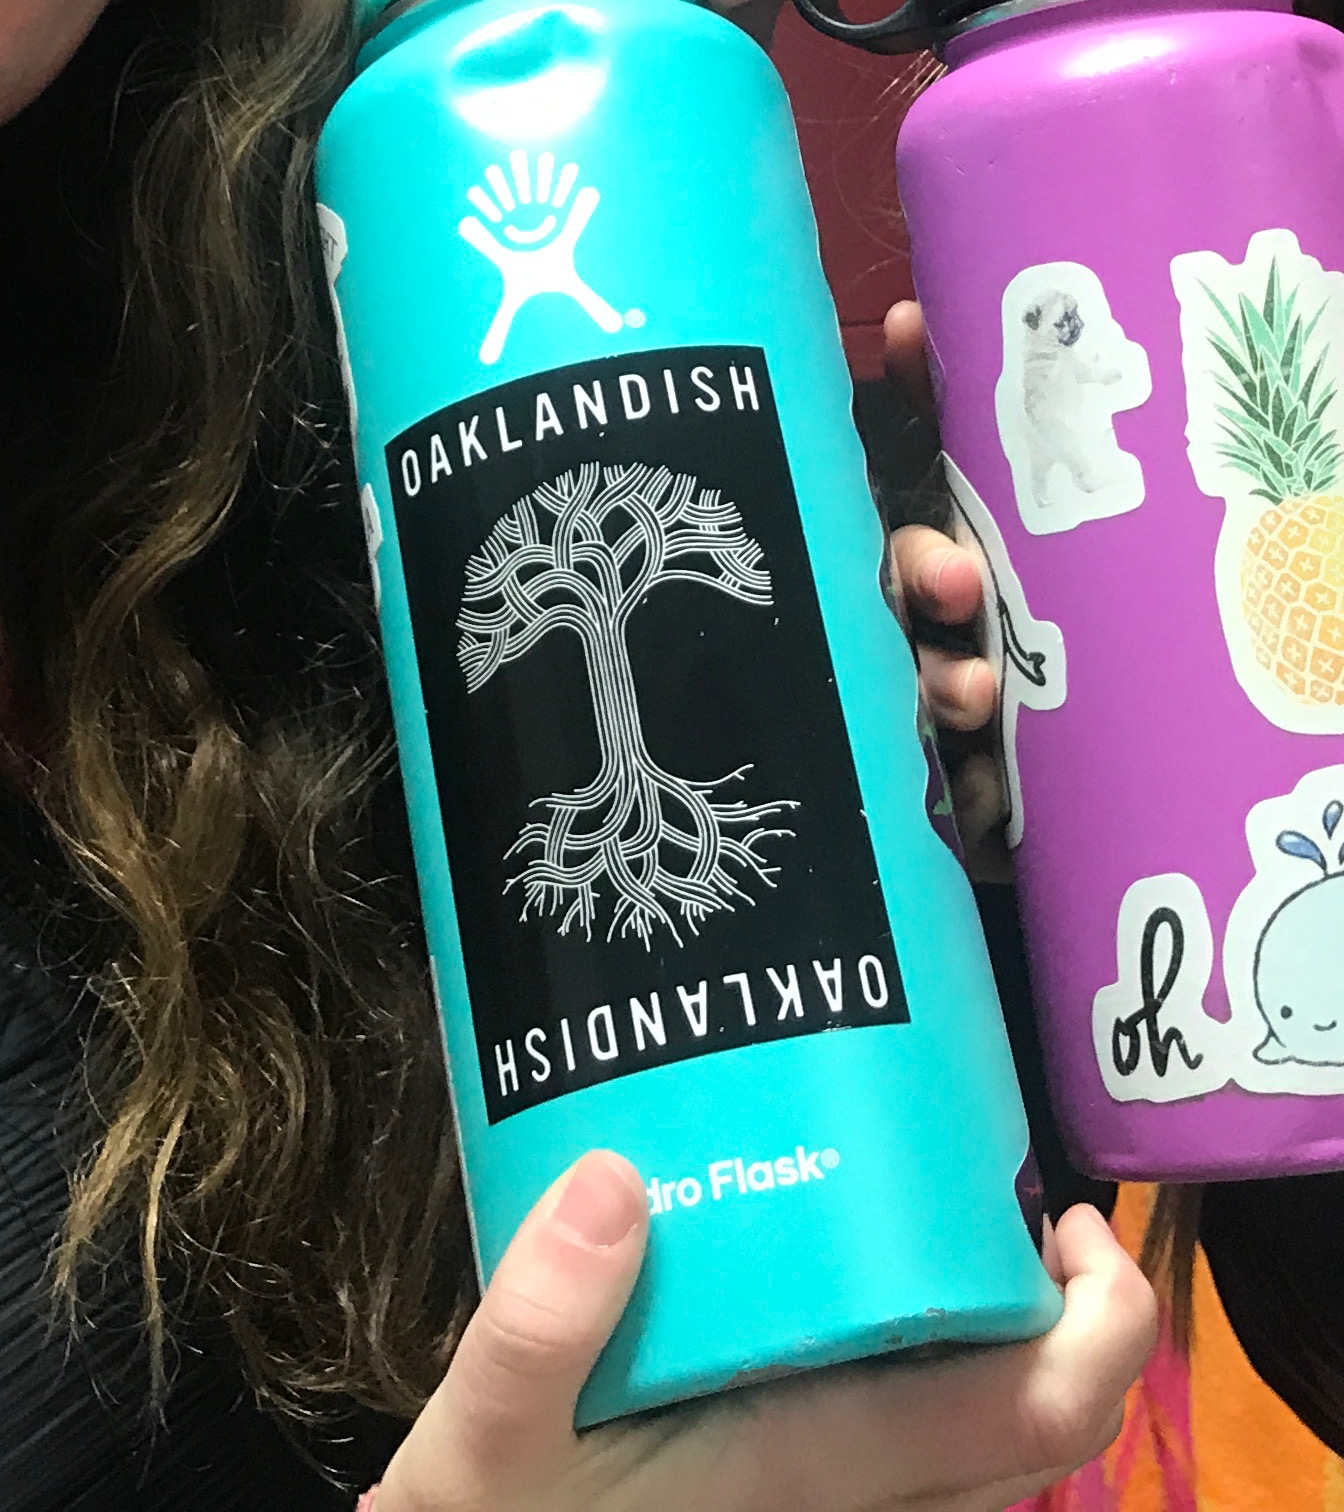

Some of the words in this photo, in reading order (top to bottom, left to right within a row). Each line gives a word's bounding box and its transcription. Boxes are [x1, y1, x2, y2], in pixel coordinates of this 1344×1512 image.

[400, 364, 760, 497] OAKLANDISH
[494, 954, 889, 1096] OAKLANDISH
[1112, 906, 1203, 1077] oh
[645, 1177, 702, 1216] dro
